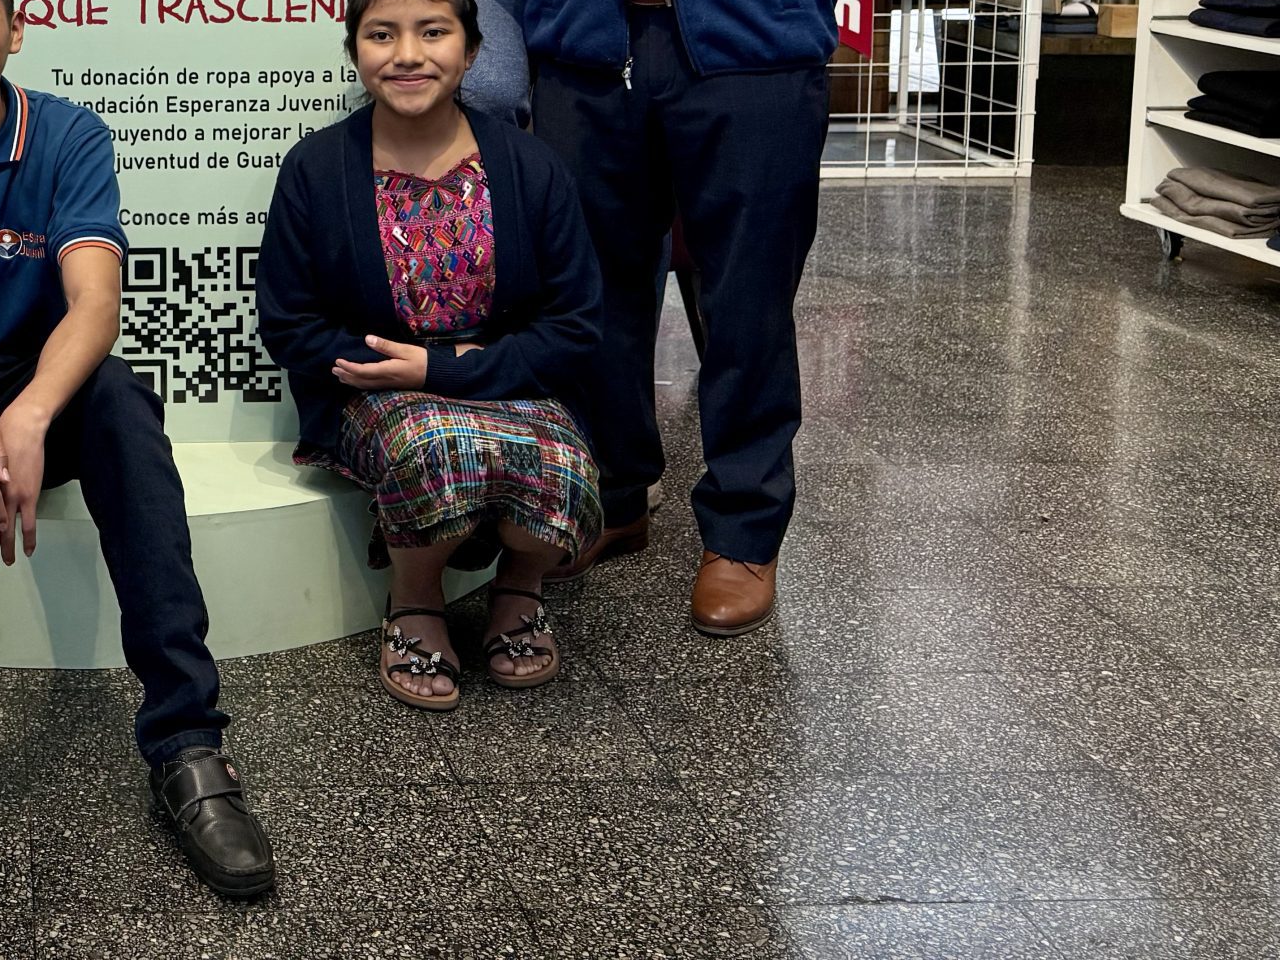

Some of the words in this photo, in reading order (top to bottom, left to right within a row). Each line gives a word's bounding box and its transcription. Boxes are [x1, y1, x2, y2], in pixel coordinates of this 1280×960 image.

[51, 68, 74, 86] Tu
[80, 66, 169, 86] donación
[176, 67, 199, 85] de
[206, 71, 250, 90] ropa
[257, 70, 315, 90] apoya
[322, 69, 333, 83] a
[341, 66, 358, 83] la
[59, 93, 159, 114] ndación
[166, 94, 270, 117] Esperanza
[276, 93, 353, 113] Juvenil,
[109, 123, 188, 146] buyendo
[194, 128, 205, 141] a
[212, 126, 293, 146] mejorar
[115, 151, 200, 174] juventud
[206, 151, 230, 169] de
[118, 208, 191, 226] Conoce
[197, 205, 239, 225] más
